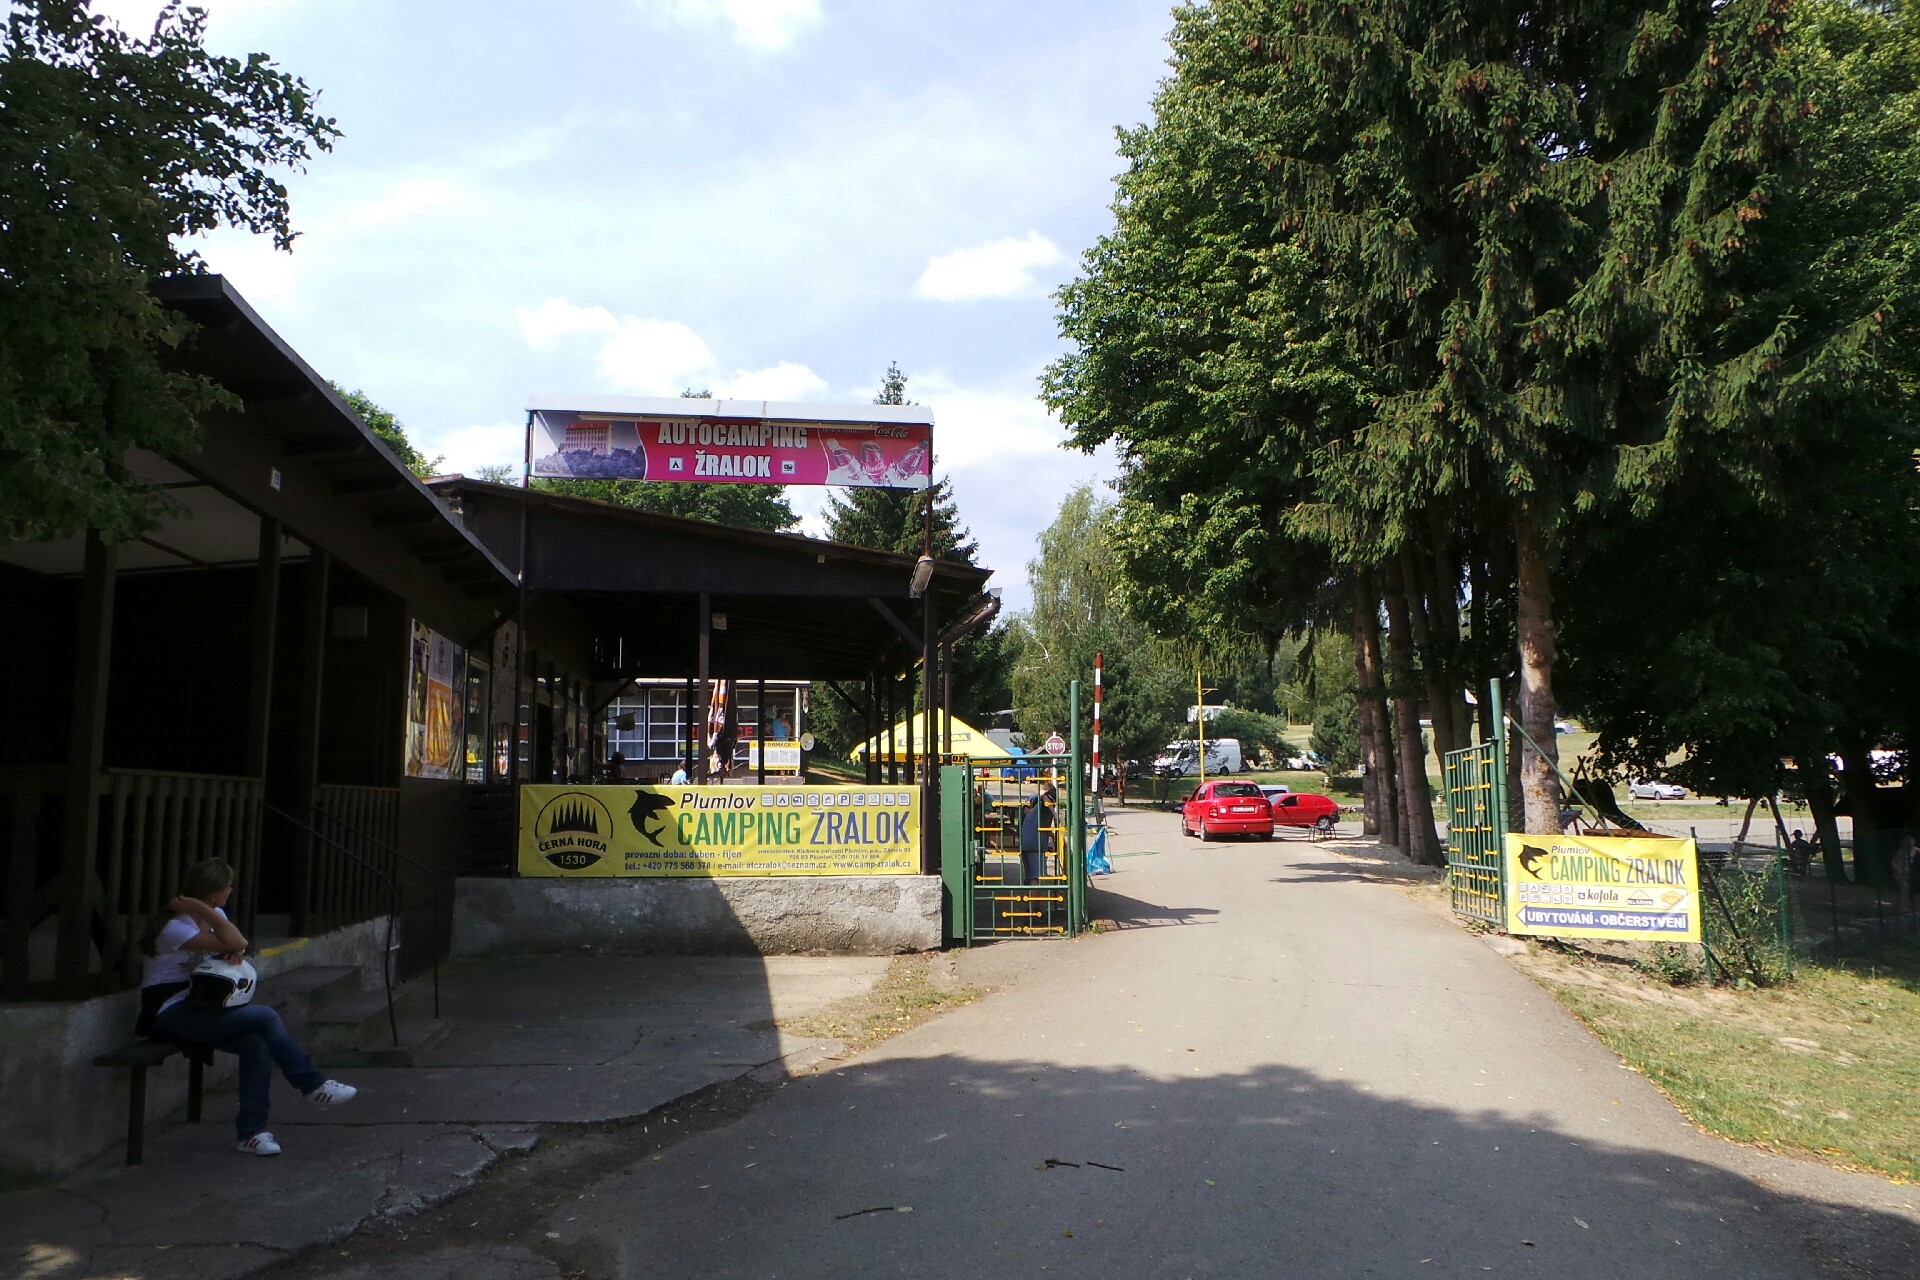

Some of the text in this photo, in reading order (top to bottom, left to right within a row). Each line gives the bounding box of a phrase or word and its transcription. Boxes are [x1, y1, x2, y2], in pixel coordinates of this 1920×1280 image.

[658, 422, 808, 448] AUTOCAMPING
[694, 449, 771, 478] ŽRALOK
[1047, 742, 1064, 751] STOP
[680, 792, 756, 809] Plumlov
[677, 808, 911, 846] CAMPING ŽRALOK
[538, 836, 607, 853] ČERNÁ HORA
[1551, 845, 1590, 854] Plumlov
[560, 855, 586, 865] 1530
[663, 850, 686, 858] doba:
[689, 850, 715, 858] duben
[625, 861, 641, 870] tel.:
[643, 861, 662, 870] +420
[664, 861, 678, 870] 775
[681, 861, 695, 870] 568
[697, 861, 711, 870] 378
[717, 861, 744, 869] e-mail:
[746, 859, 827, 870] atczralok@seznam.cz
[833, 859, 911, 869] www.camp-zralok.cz
[1551, 856, 1686, 884] CAMPING ŽRALOK
[1587, 888, 1619, 903] kofola
[1527, 911, 1594, 924] UBYTOVÁNÍ
[1600, 913, 1686, 928] OBČERSTVENÍ
